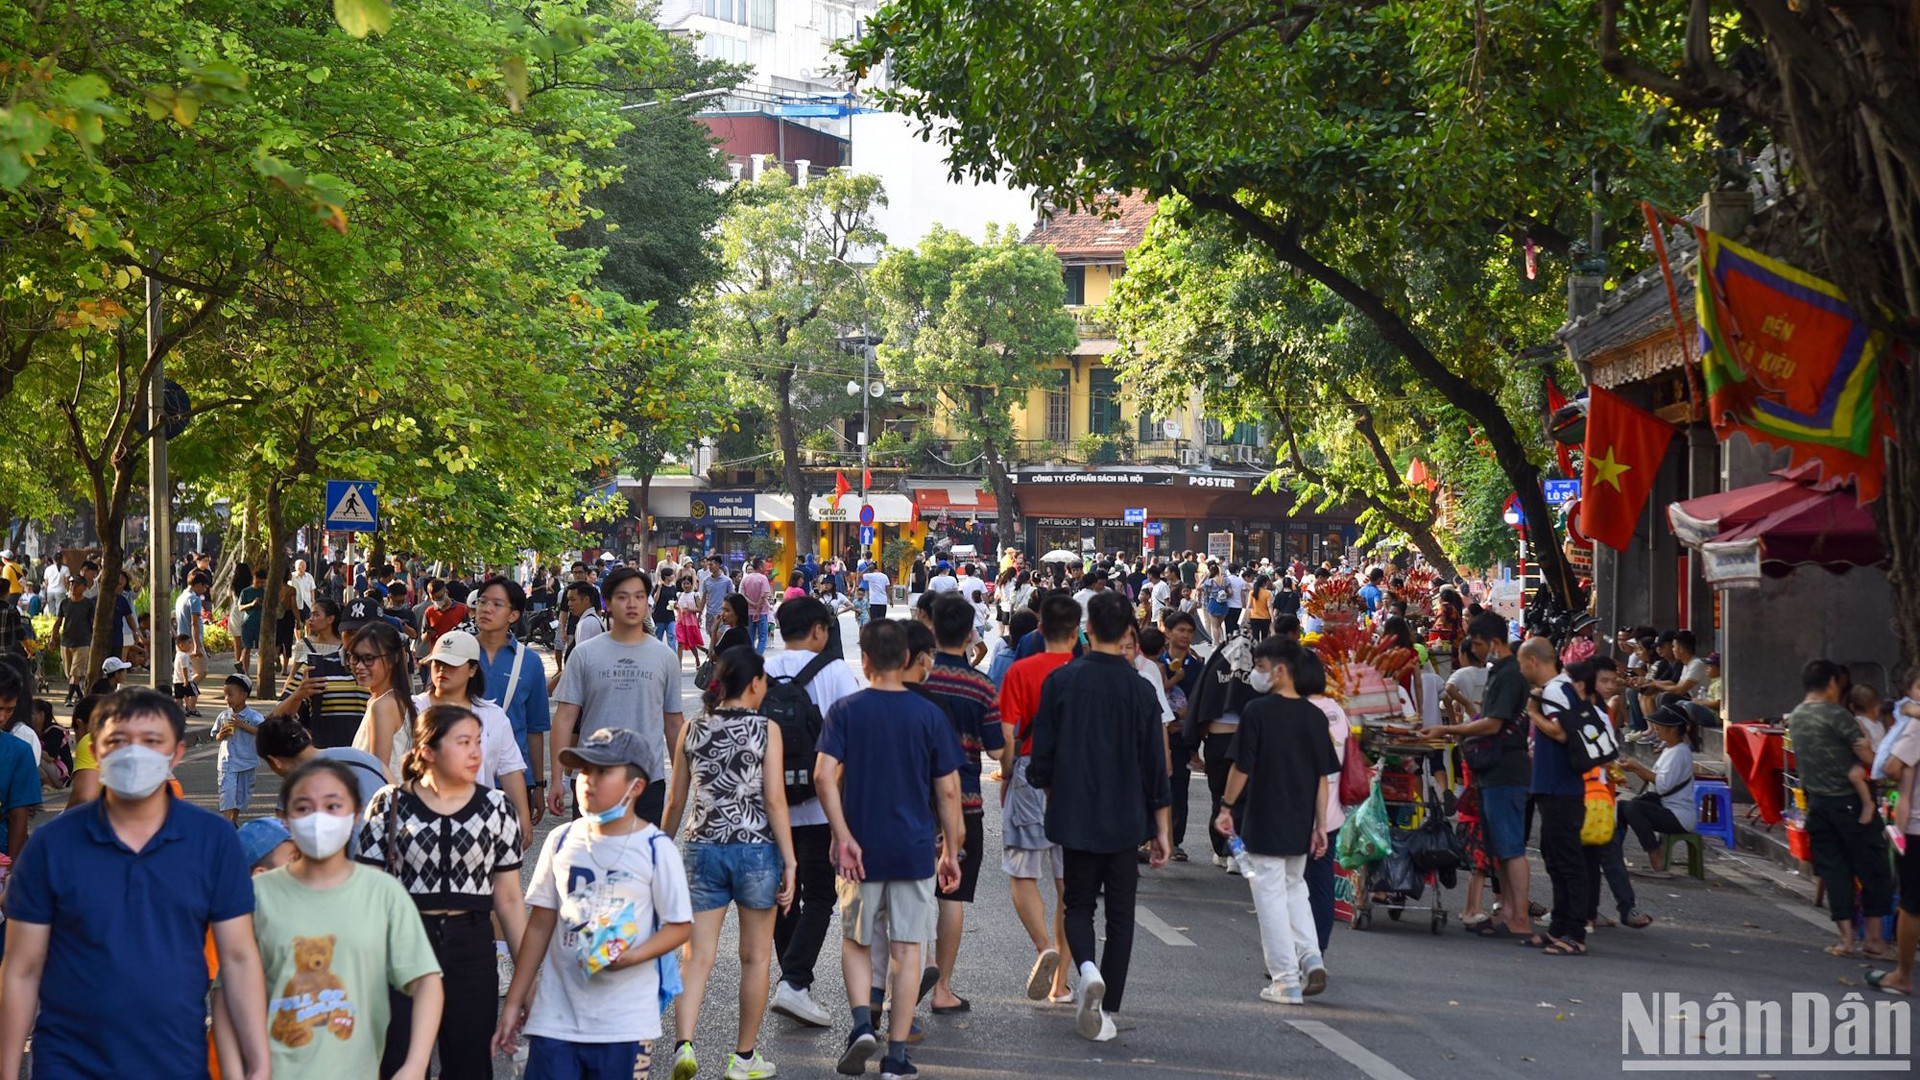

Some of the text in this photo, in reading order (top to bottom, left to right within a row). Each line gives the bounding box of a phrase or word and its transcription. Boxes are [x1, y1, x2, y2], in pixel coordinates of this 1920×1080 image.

[1031, 474, 1053, 482] CÔNG
[1097, 474, 1116, 483] SÁCH
[1117, 474, 1129, 483] HÀ
[1129, 474, 1144, 484] NỘI
[1189, 476, 1235, 488] POSTER
[1547, 489, 1560, 500] LÒ
[709, 506, 732, 516] Thanh
[1080, 517, 1096, 527] 53
[598, 669, 653, 681] THE NORTH FACE
